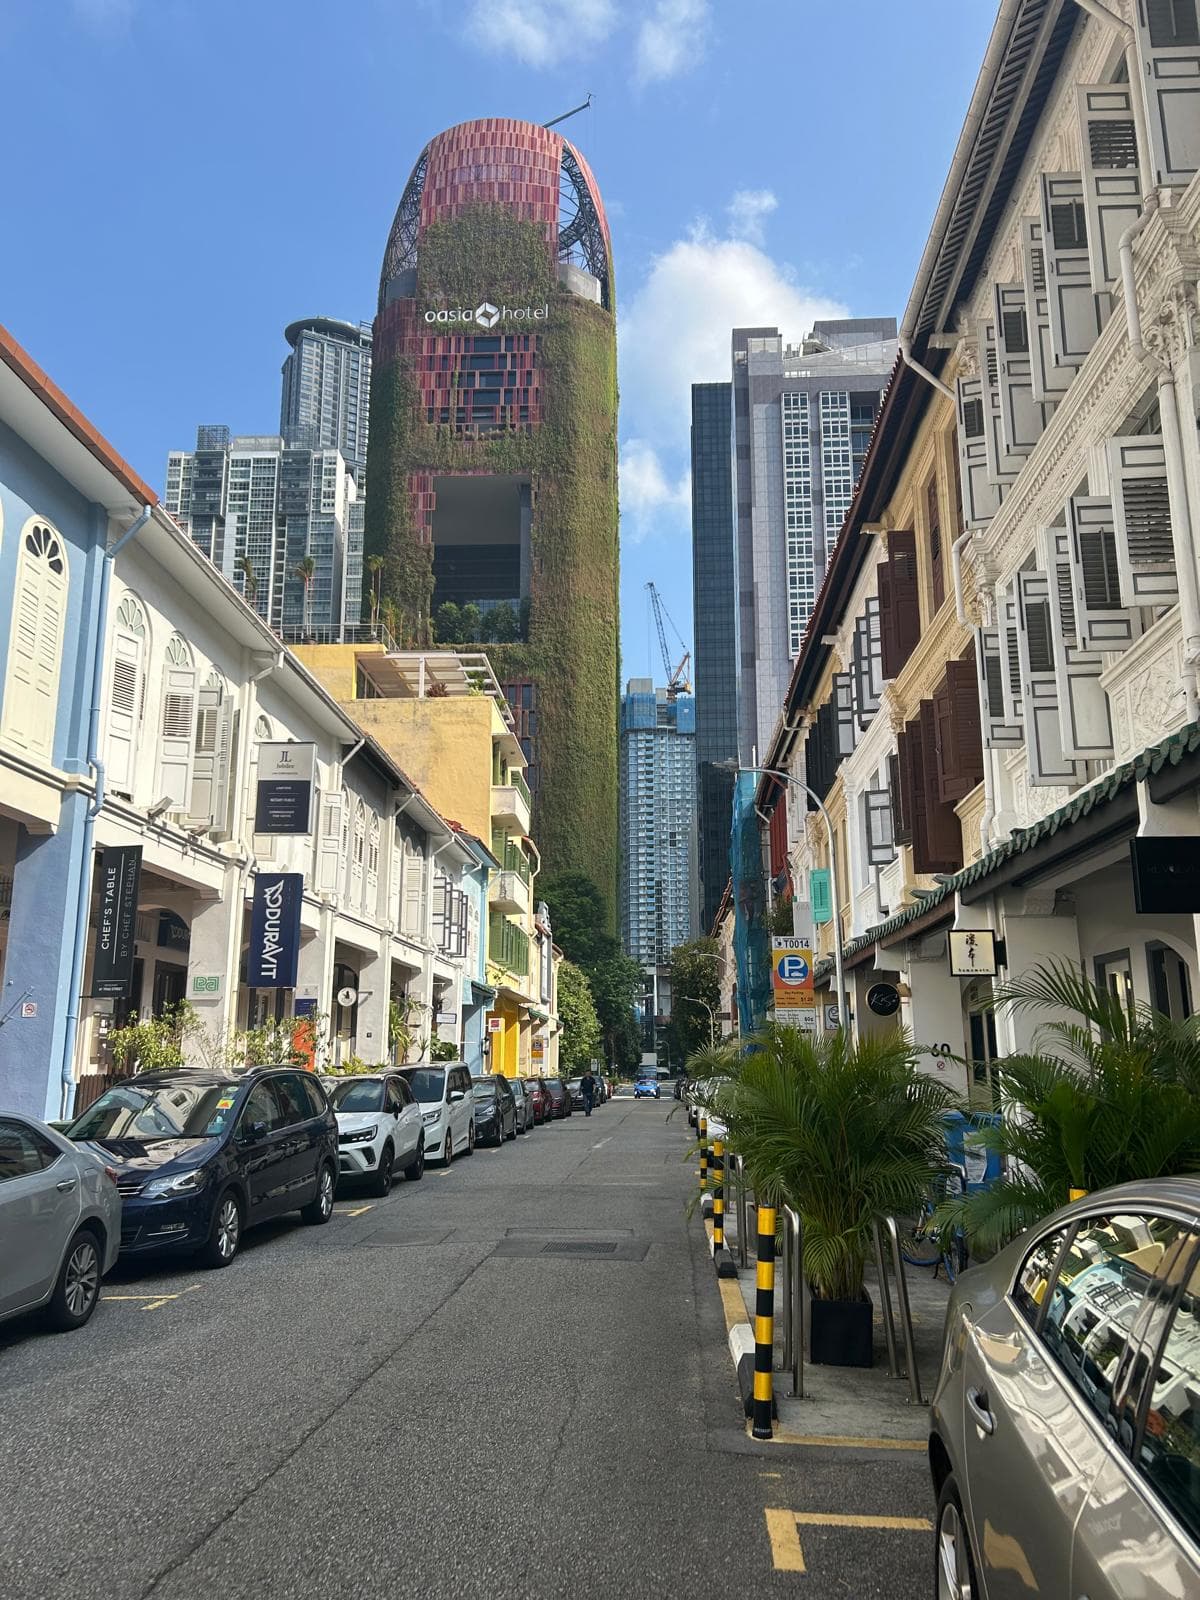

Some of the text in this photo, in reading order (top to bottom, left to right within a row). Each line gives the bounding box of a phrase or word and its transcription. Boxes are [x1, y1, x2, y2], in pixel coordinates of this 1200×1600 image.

[425, 303, 549, 322] oasia hotel
[101, 867, 117, 950] CHEF'S TABLE
[122, 912, 131, 939] CHEF
[120, 944, 128, 957] BY
[260, 908, 284, 980] DURAVIT
[783, 939, 810, 949] T0014
[784, 956, 805, 977] P
[931, 1043, 951, 1058] 60
